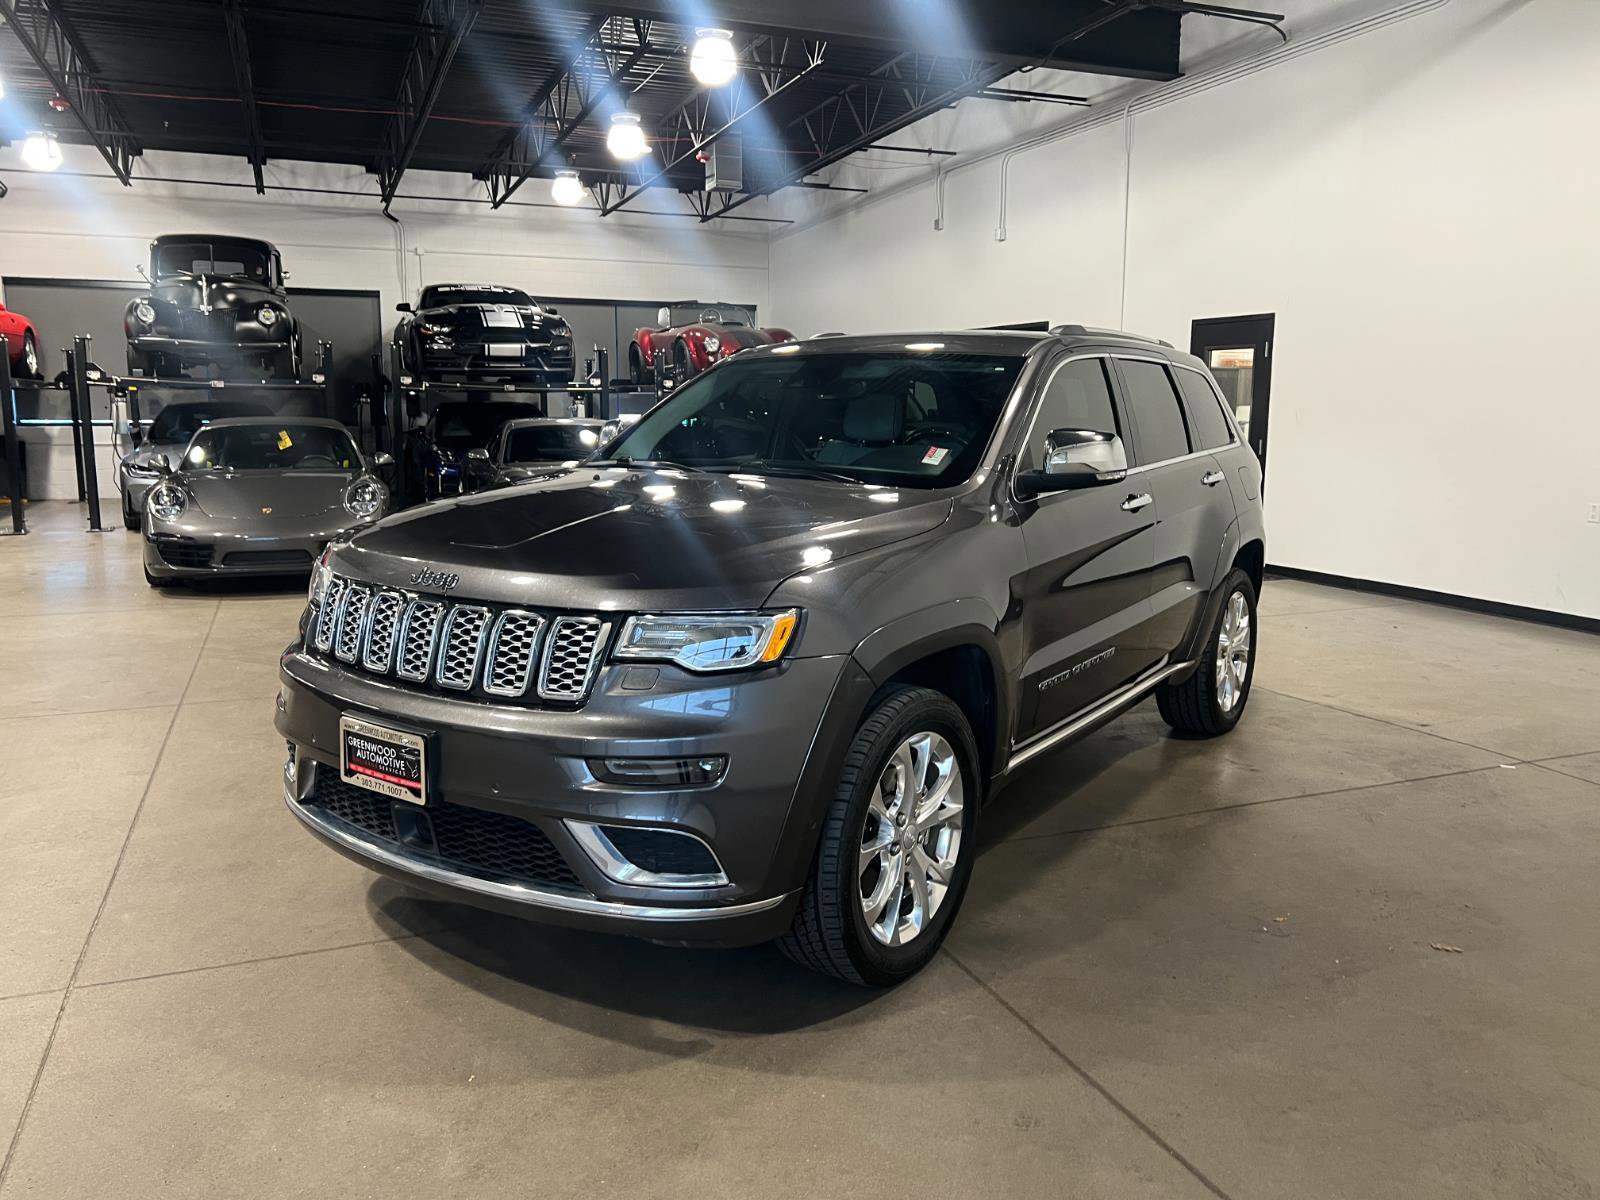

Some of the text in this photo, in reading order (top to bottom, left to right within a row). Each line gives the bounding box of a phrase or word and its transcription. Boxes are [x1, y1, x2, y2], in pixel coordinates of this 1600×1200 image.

[410, 567, 459, 593] Jeep
[348, 736, 397, 758] GREENWOOD
[356, 749, 406, 771] AUTOMOTIVE
[361, 778, 402, 796] 303.771.1007
